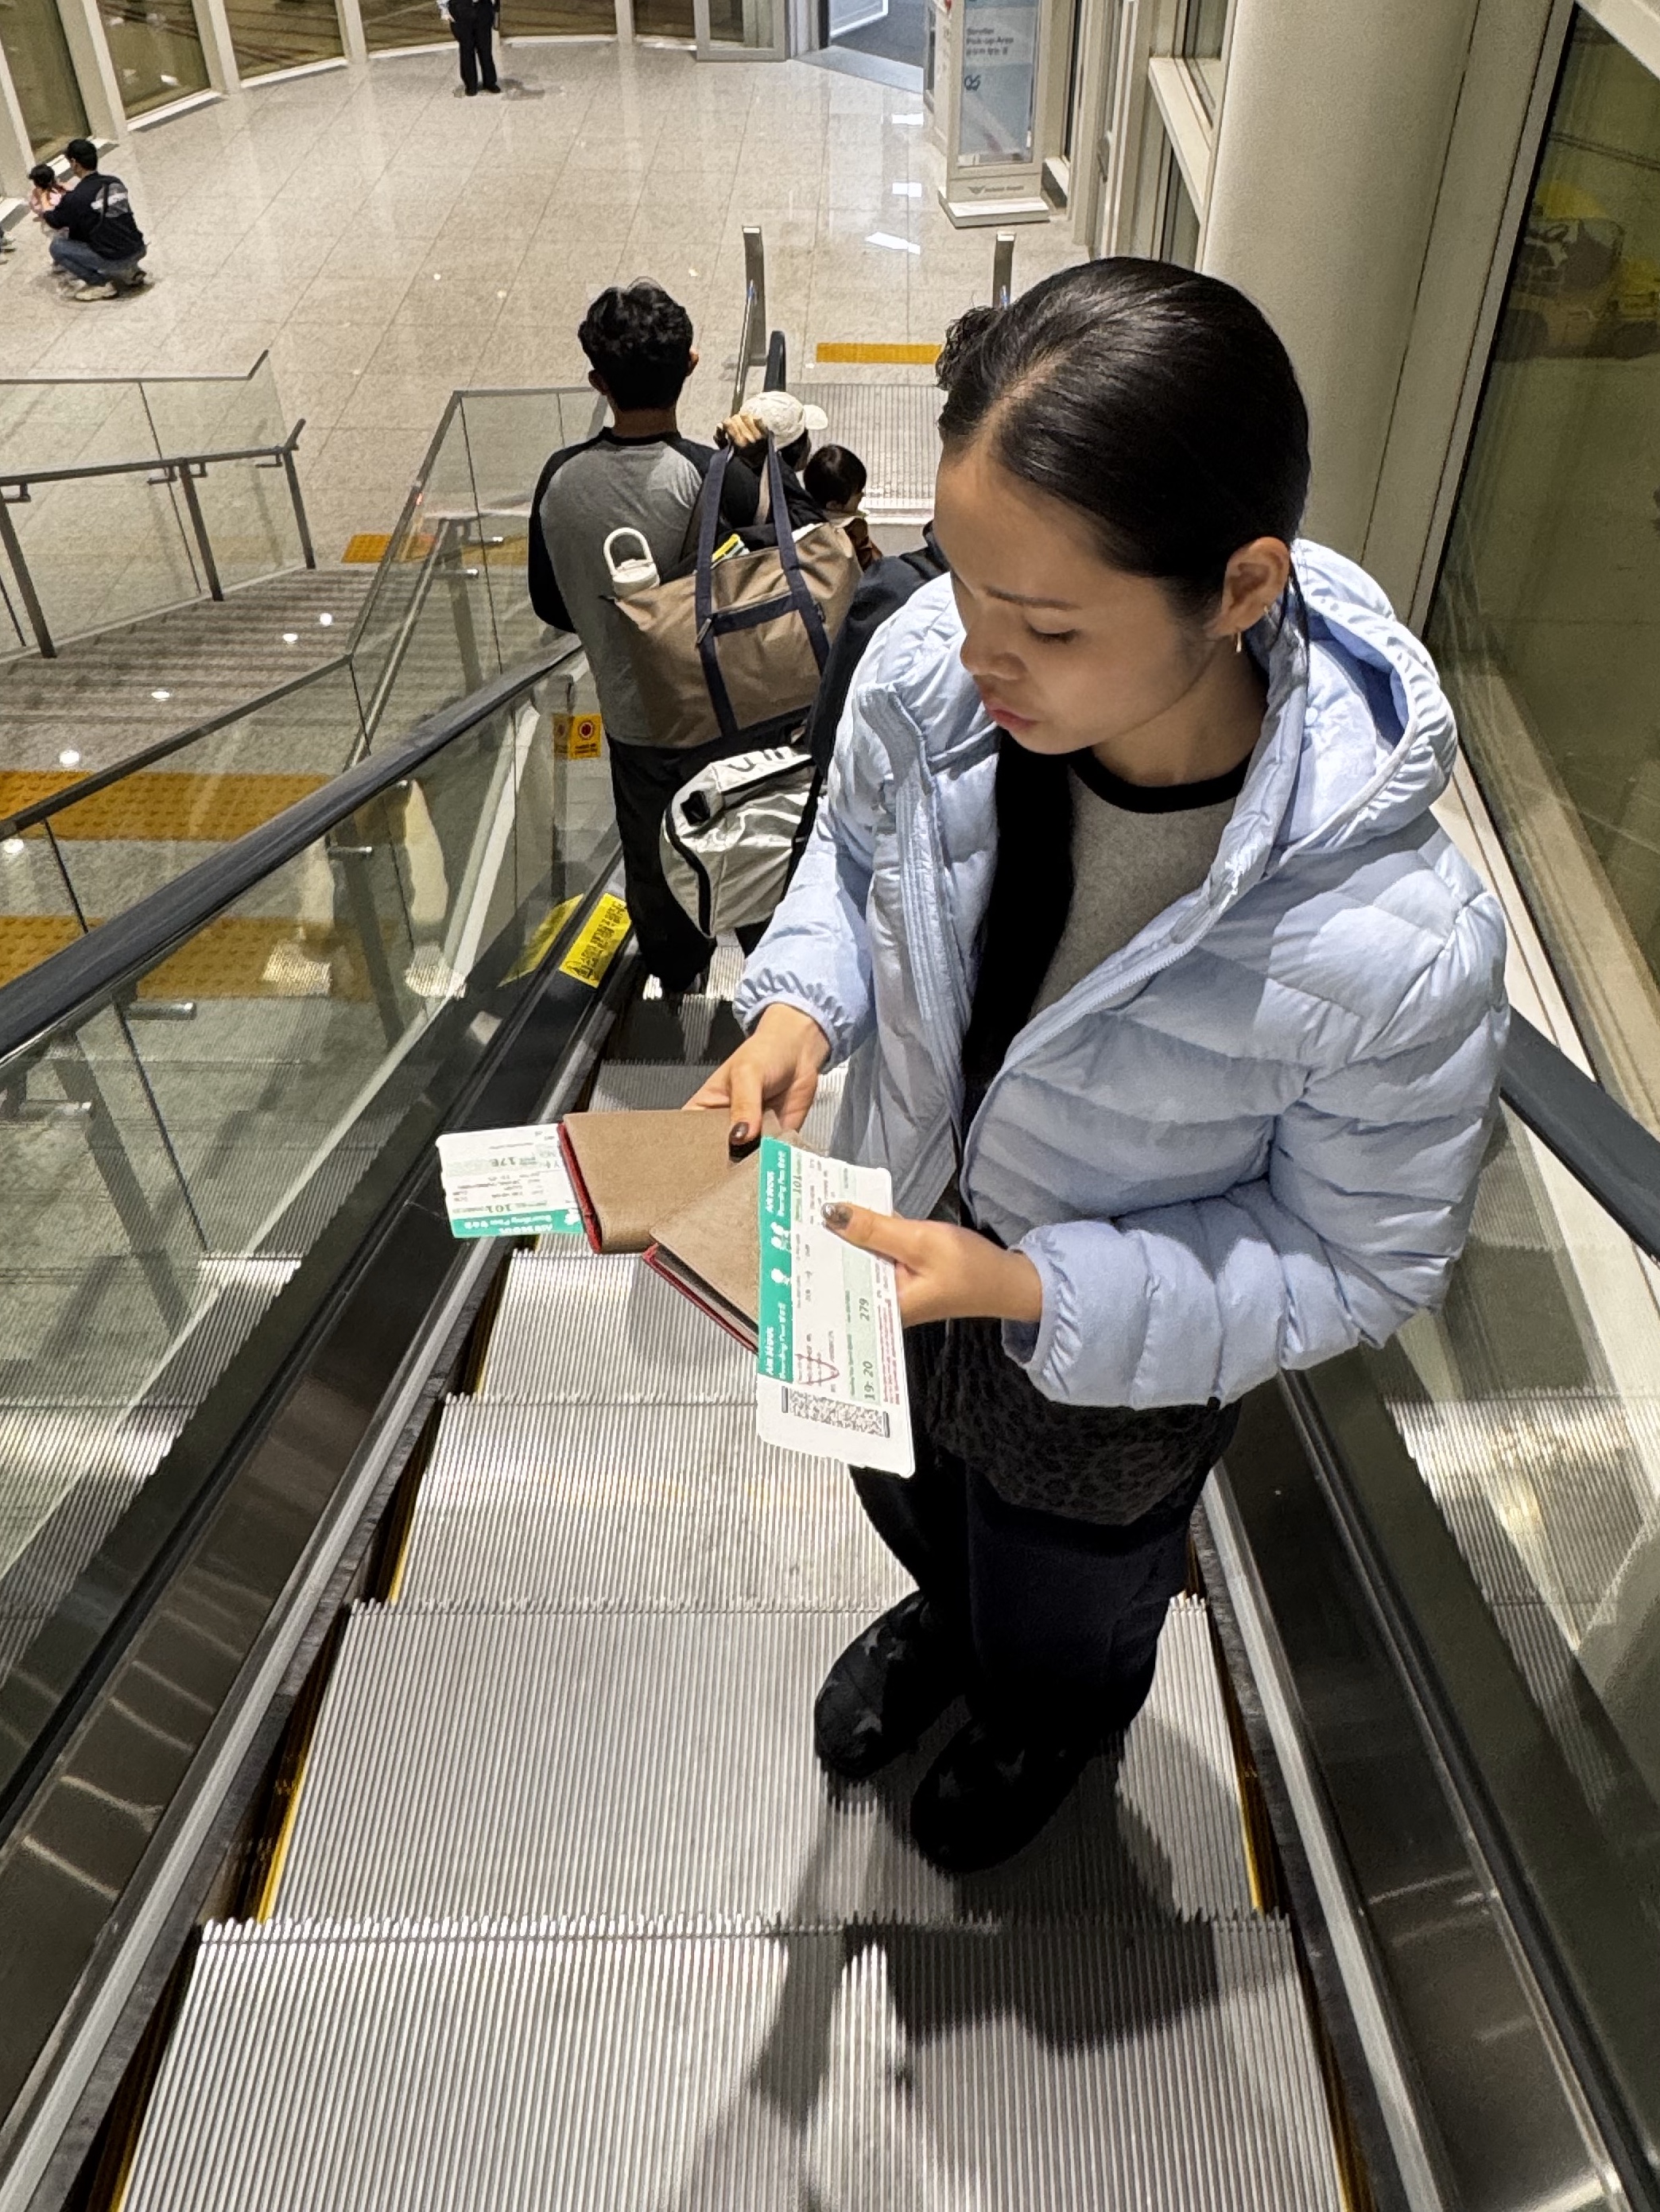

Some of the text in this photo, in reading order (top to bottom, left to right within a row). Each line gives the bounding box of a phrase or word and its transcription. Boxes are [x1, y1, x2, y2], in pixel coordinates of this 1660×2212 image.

[792, 1174, 803, 1193] 101
[486, 1205, 512, 1213] 101
[859, 1297, 871, 1321] 279
